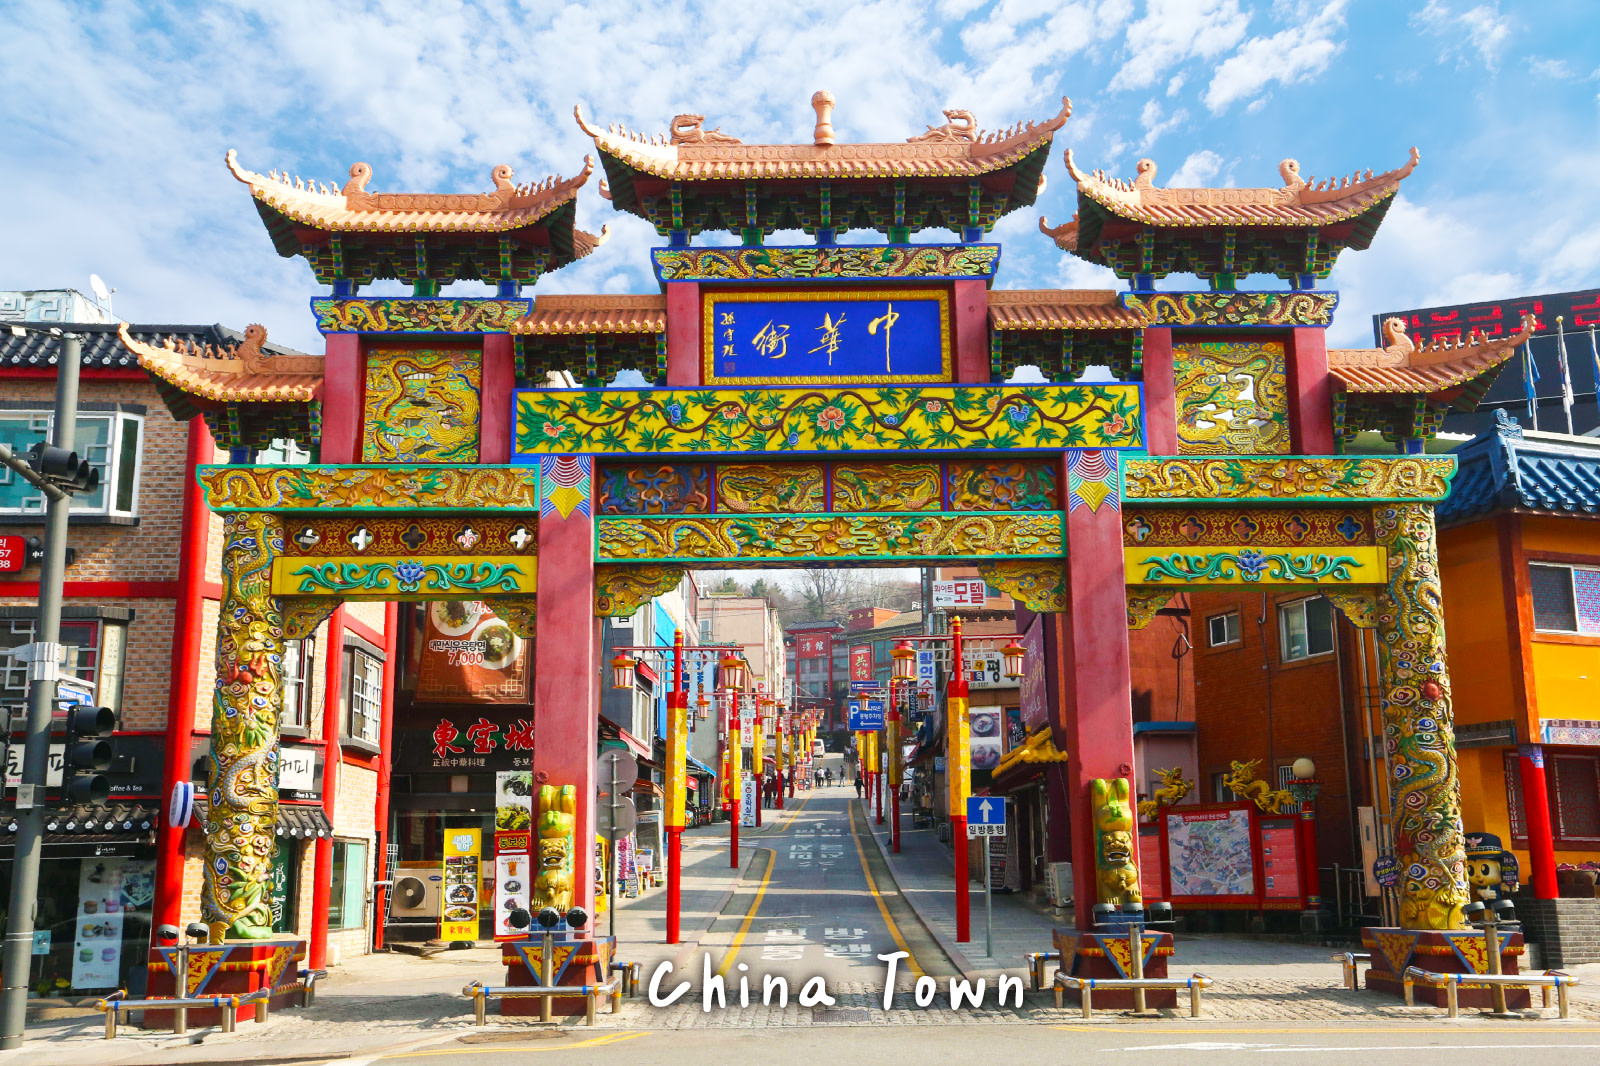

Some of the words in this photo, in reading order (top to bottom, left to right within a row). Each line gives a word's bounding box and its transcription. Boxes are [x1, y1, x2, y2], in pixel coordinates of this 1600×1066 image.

[954, 583, 984, 604] 모텔
[448, 653, 484, 666] 7,000
[855, 654, 867, 679] 共和
[850, 705, 859, 720] P
[432, 757, 486, 767] 正統中華料理
[969, 825, 1004, 834] 일방통행
[498, 837, 527, 848] 동보성
